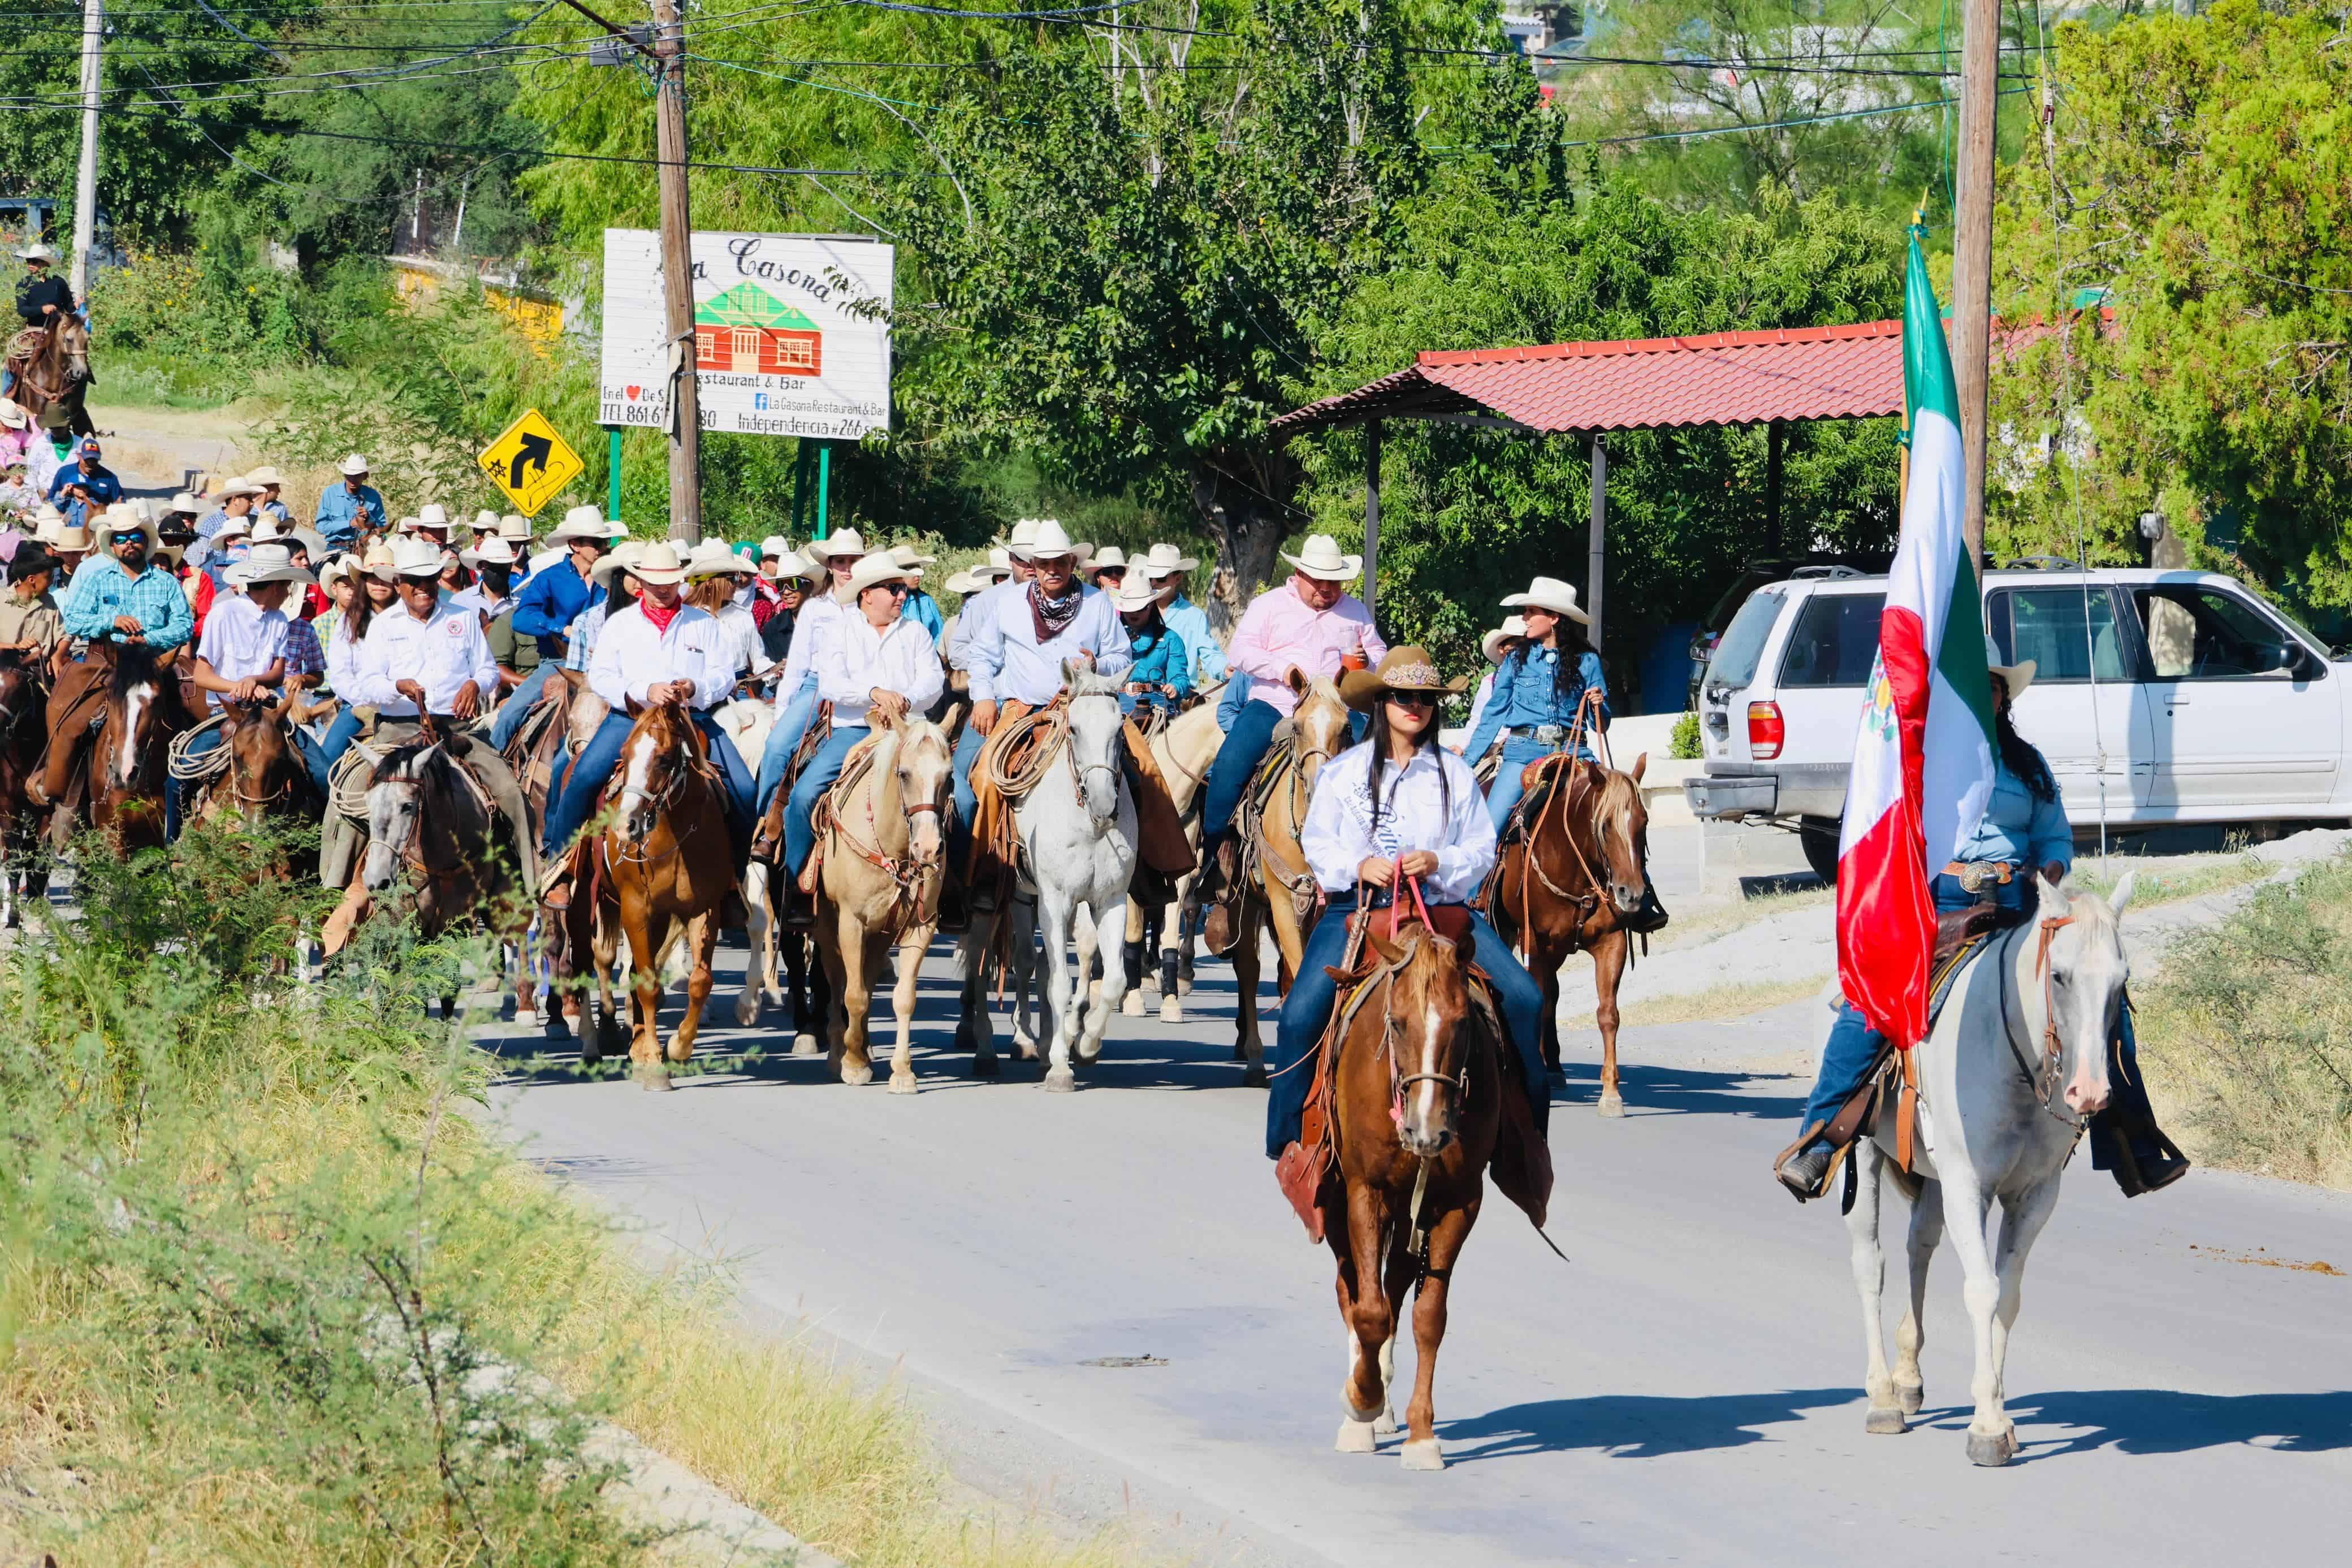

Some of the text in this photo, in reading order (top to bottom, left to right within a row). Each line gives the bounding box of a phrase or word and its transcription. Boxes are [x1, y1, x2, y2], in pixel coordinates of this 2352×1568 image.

[691, 239, 831, 303] a Casona
[696, 372, 806, 390] estaurant & Bar
[642, 388, 656, 402] De
[738, 413, 829, 435] Independencia
